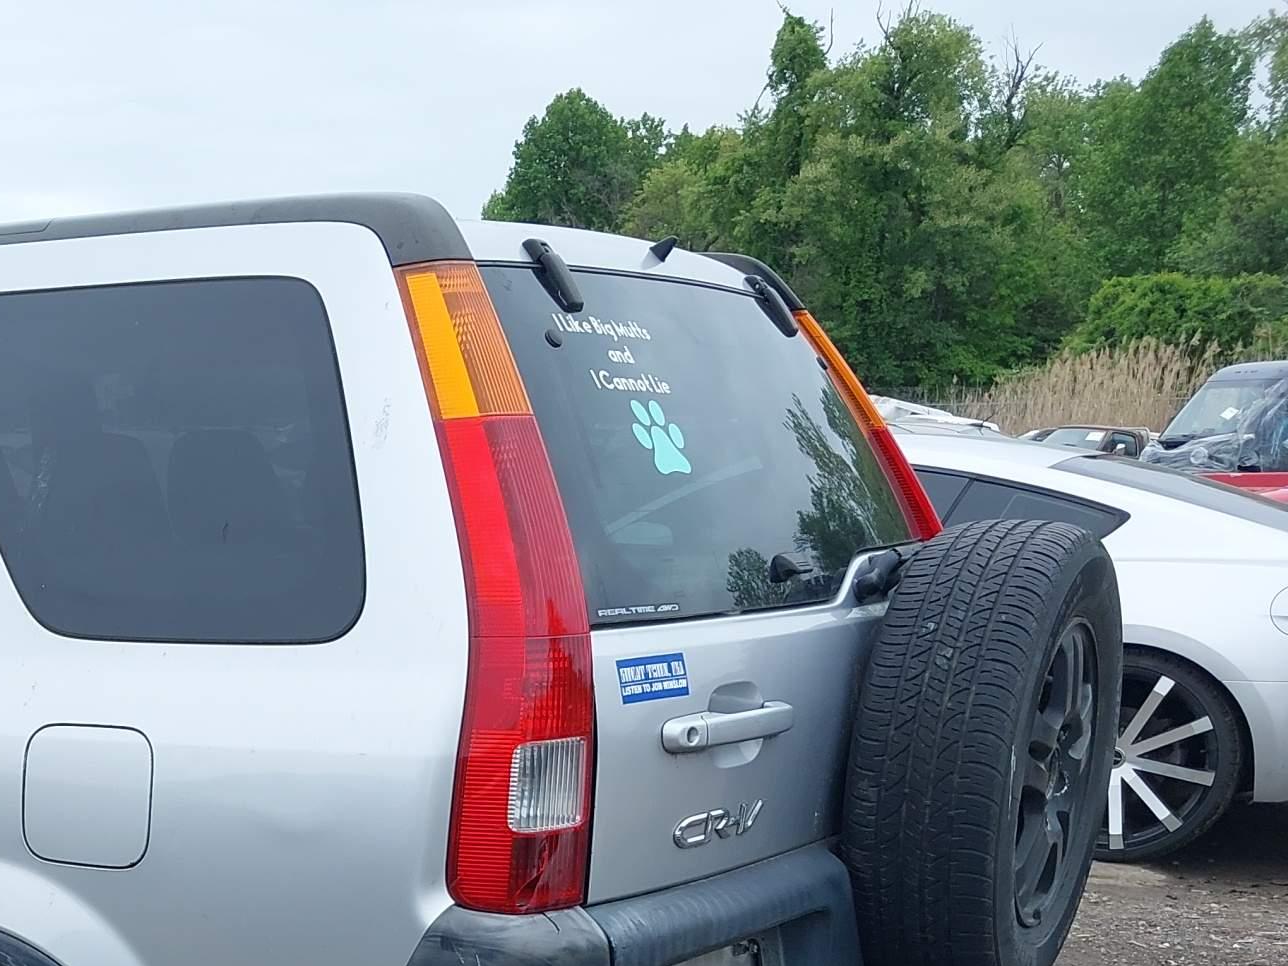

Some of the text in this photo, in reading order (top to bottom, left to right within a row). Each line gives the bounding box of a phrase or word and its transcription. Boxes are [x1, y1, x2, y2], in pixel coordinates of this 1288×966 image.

[552, 313, 651, 341] I Like Big Mutts
[608, 346, 635, 364] and
[590, 369, 671, 394] I Cannot Lie
[642, 683, 651, 693] TO
[673, 799, 764, 849] CR-V
